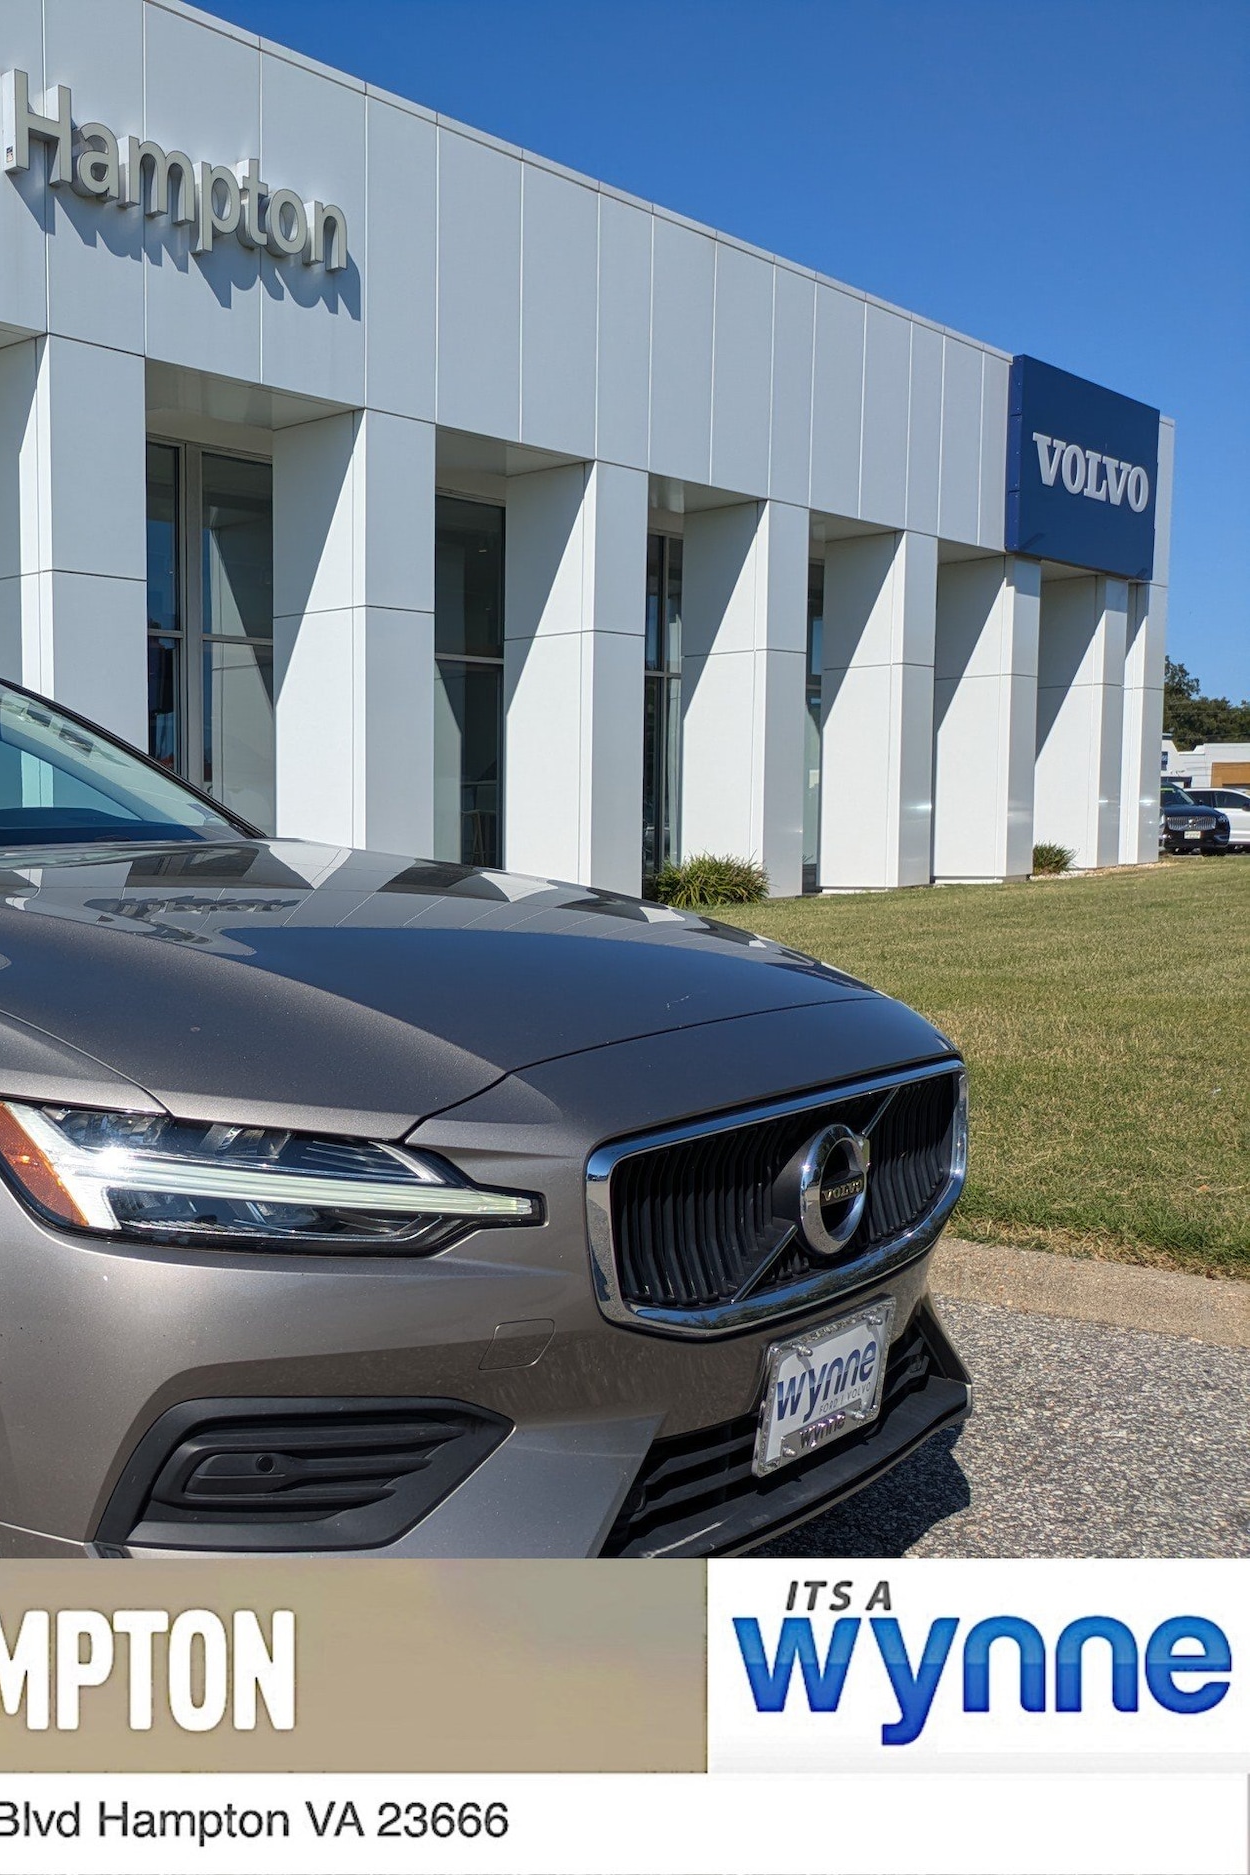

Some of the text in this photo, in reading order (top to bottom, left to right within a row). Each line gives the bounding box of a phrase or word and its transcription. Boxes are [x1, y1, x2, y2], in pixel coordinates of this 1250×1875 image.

[2, 68, 348, 271] Hampton
[1032, 431, 1150, 513] VOLVO
[821, 1179, 863, 1201] VOLVO
[776, 1340, 877, 1424] wynne
[800, 1410, 846, 1448] wynne
